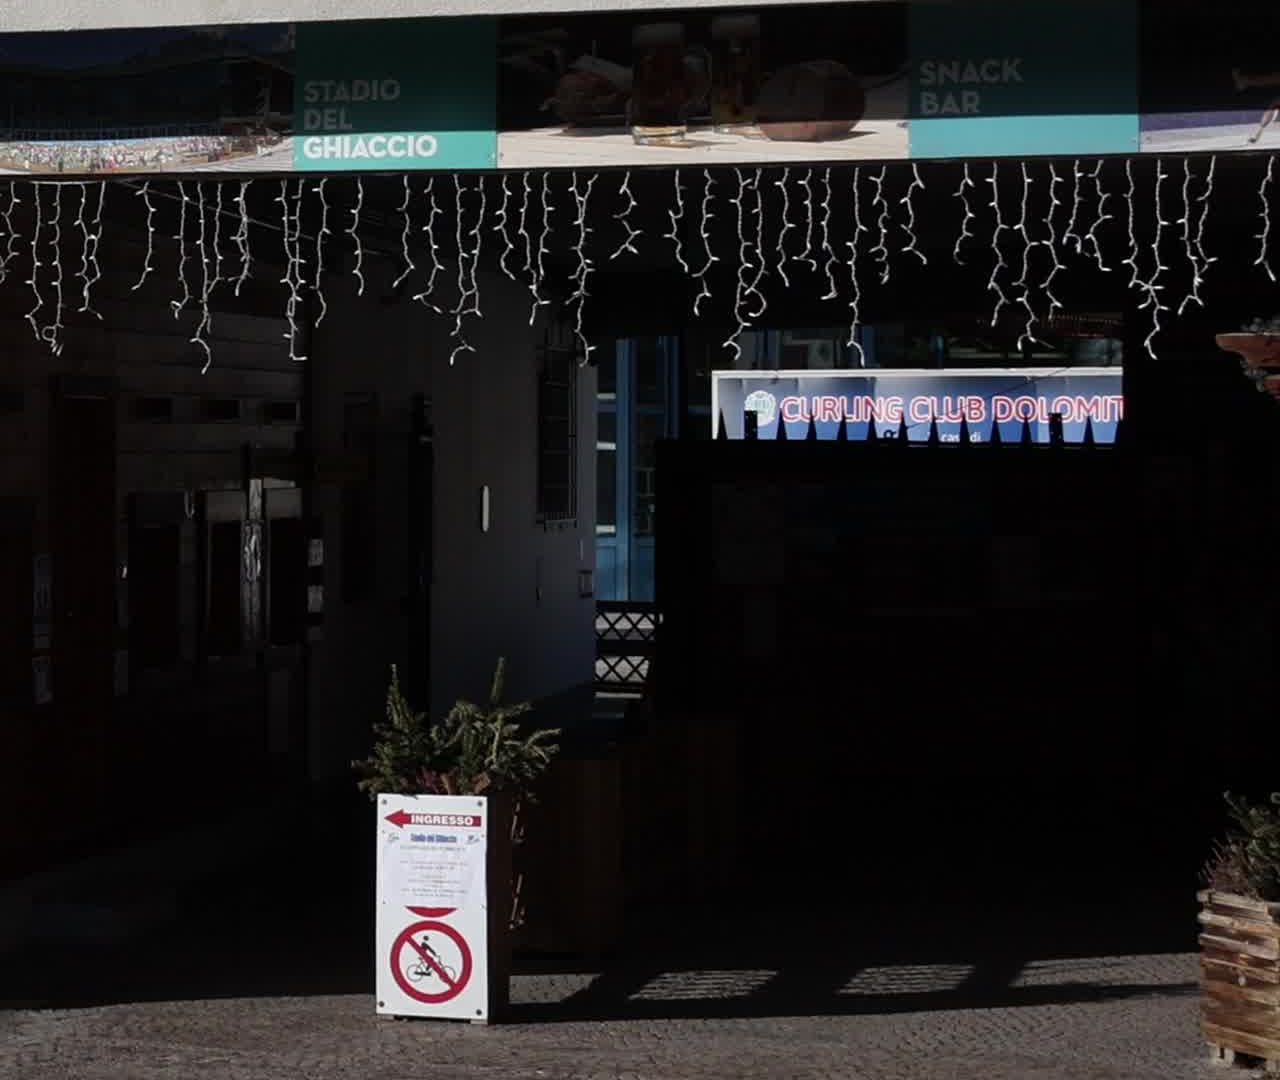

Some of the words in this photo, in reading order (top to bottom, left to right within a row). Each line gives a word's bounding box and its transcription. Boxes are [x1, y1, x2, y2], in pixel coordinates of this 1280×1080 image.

[920, 58, 1024, 85] SNACK
[304, 80, 400, 103] STADIO
[920, 91, 980, 114] BAR
[304, 107, 352, 130] DEL
[304, 135, 438, 159] GHIACCIO
[781, 396, 903, 423] CURLING
[910, 396, 985, 423] CLUB
[410, 814, 474, 826] INGRESSO
